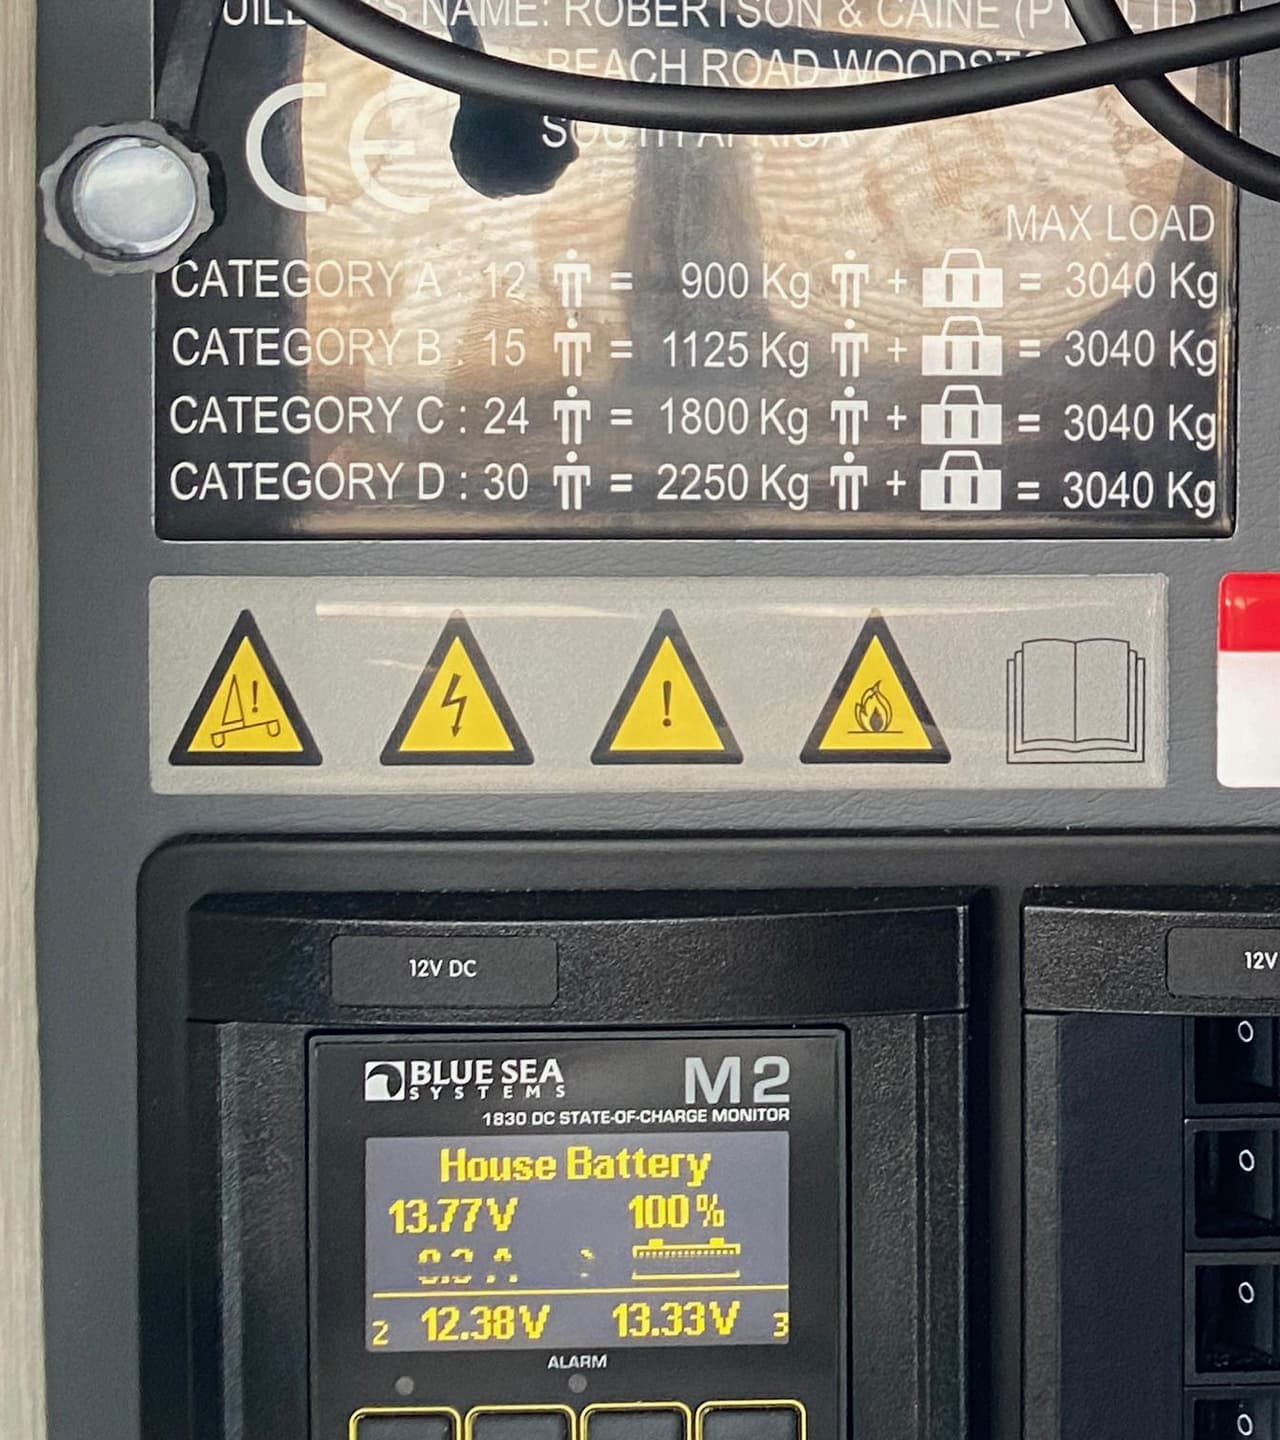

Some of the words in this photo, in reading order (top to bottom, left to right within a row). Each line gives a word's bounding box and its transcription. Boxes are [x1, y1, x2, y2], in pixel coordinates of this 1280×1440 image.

[1004, 204, 1099, 244] MAX
[1105, 204, 1215, 244] LOAD
[170, 258, 401, 300] CATEGORY
[406, 259, 439, 300] A
[483, 261, 525, 300] 12
[680, 261, 752, 301] 900
[760, 261, 811, 310] Kg
[1064, 262, 1157, 301] 3040
[1168, 262, 1219, 310] Kg
[409, 959, 443, 978] 12V
[449, 959, 477, 978] DC
[410, 1059, 494, 1086] BLUE
[501, 1058, 565, 1084] SEA
[409, 1084, 566, 1100] SYSTEMS
[482, 1111, 527, 1127] 1830
[531, 1111, 556, 1126] DC
[559, 1108, 708, 1125] STATE-OF-CHARGE
[711, 1107, 790, 1123] MONITOR
[439, 1148, 558, 1184] House
[564, 1145, 712, 1188] Battery
[628, 1194, 686, 1229] 100
[547, 1354, 608, 1369] ALARM
